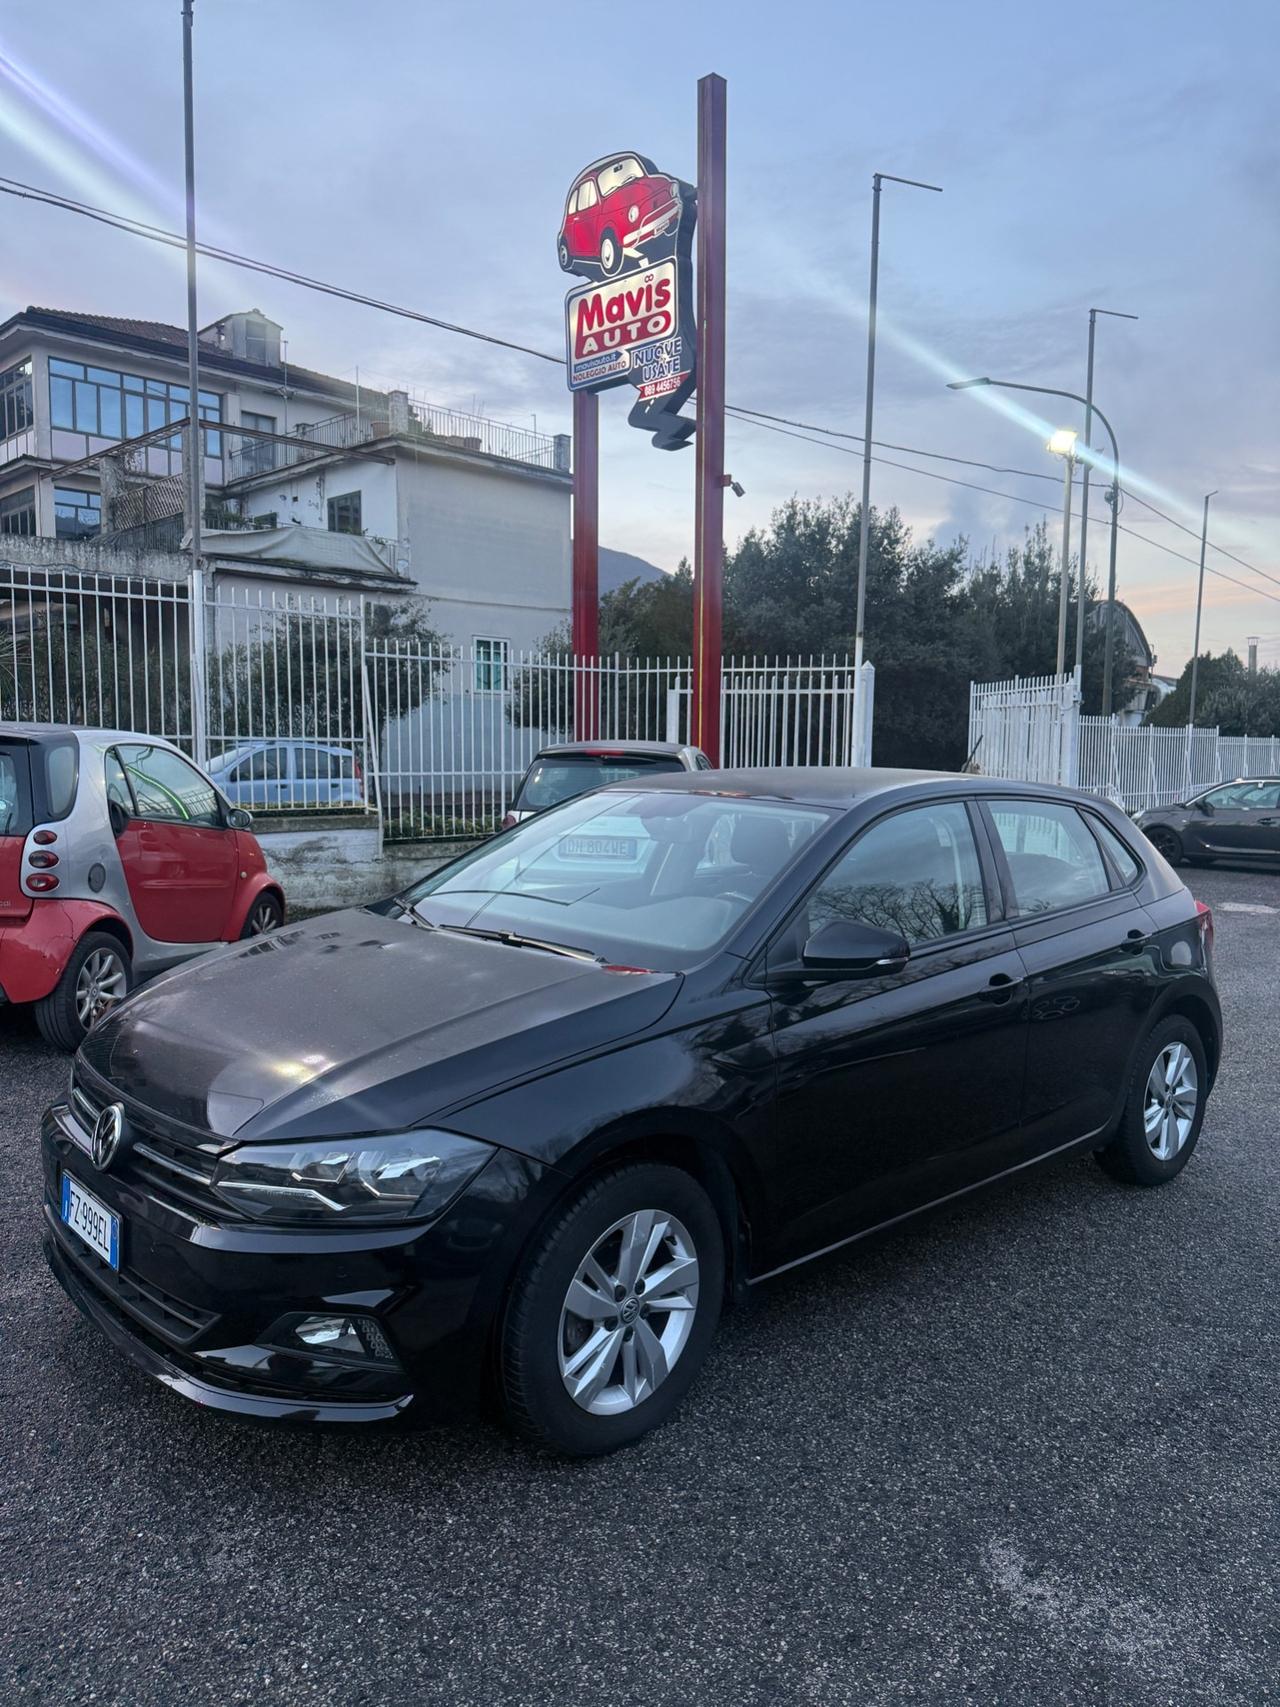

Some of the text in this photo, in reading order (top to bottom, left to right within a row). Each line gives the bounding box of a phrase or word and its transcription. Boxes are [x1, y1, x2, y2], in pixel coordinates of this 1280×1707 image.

[578, 274, 671, 331] Mavis
[582, 315, 666, 355] AUTO
[633, 337, 682, 368] NUOVE
[573, 360, 626, 382] NOLEGGIO AUTO
[642, 356, 680, 382] USATE
